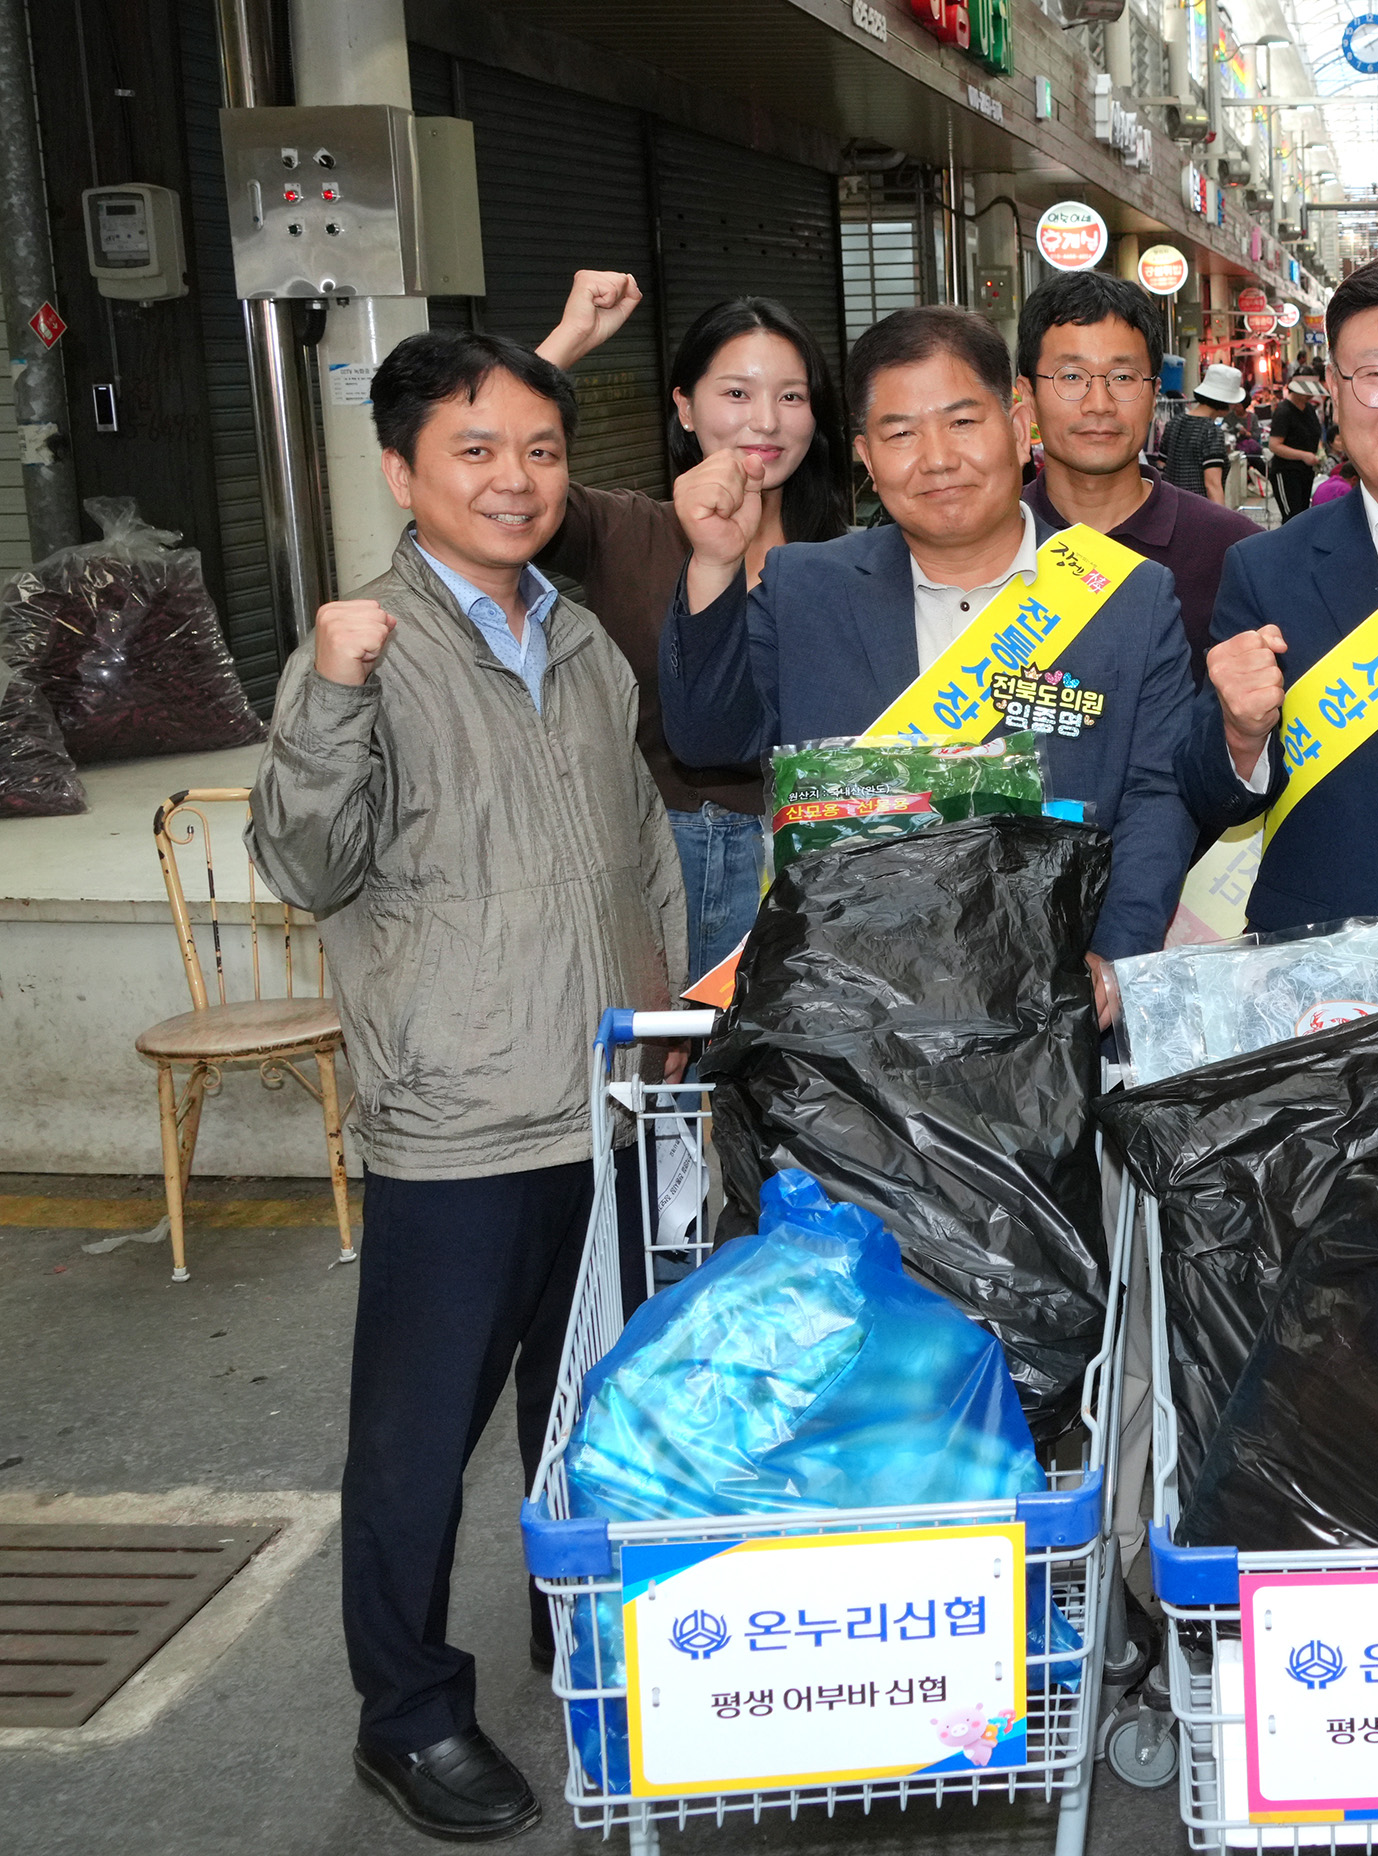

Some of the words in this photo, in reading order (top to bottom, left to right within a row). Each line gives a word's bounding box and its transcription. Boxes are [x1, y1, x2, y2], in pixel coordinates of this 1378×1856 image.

[933, 597, 1061, 730] 전통시장
[1005, 701, 1083, 738] 임종명
[786, 803, 839, 820] 산모용
[788, 790, 819, 802] 원산지
[744, 1595, 986, 1652] 온누리신협
[711, 1688, 774, 1719] 평생
[783, 1681, 880, 1713] 어부바
[886, 1675, 948, 1706] 신협
